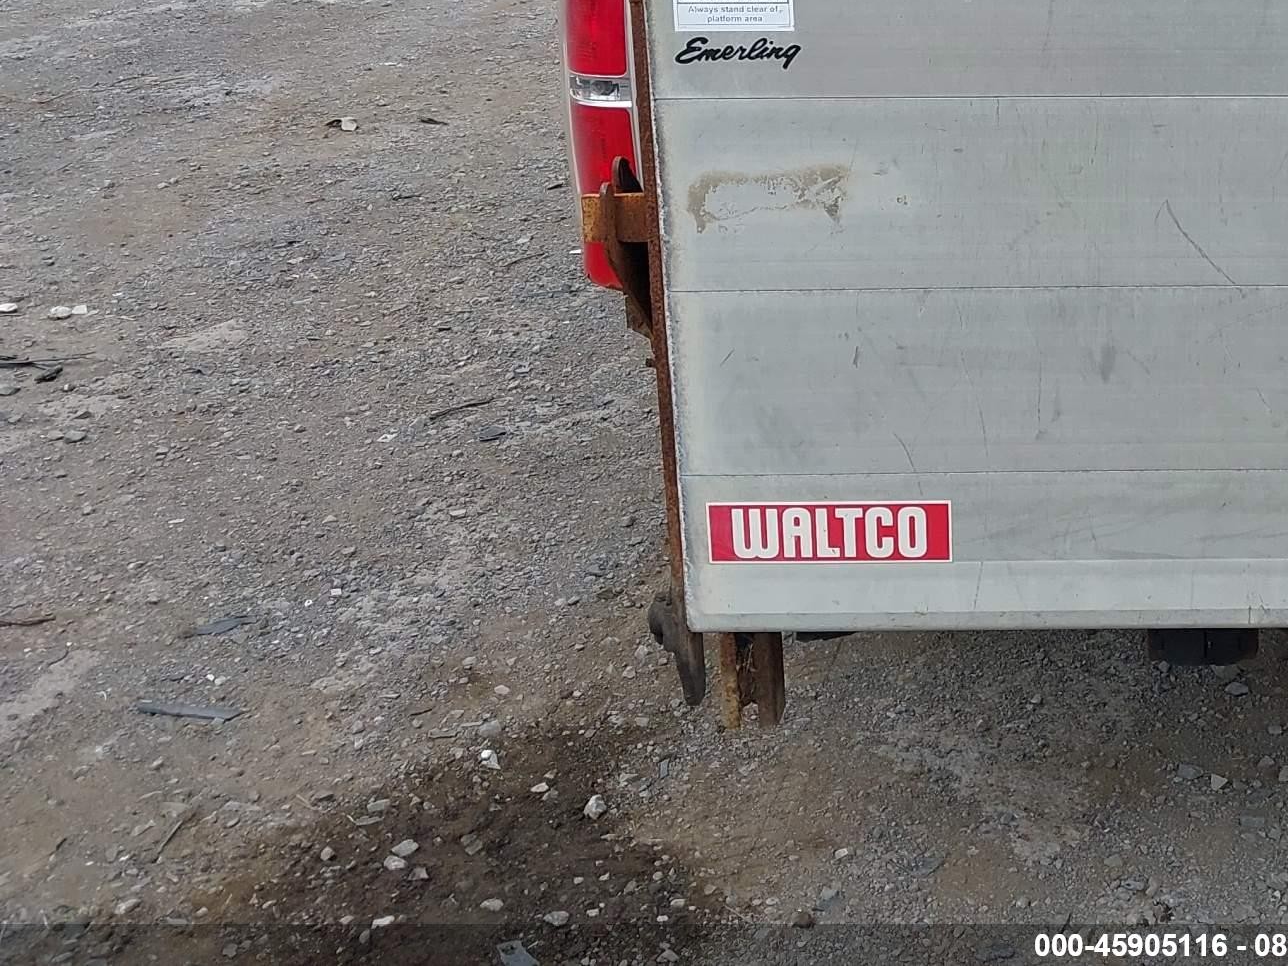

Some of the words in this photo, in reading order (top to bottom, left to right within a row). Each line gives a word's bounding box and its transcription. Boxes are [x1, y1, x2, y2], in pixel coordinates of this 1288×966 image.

[688, 6, 719, 14] Always
[721, 5, 744, 13] stand
[747, 5, 767, 13] clear
[707, 15, 742, 23] platform
[675, 36, 802, 70] Emerling
[731, 506, 928, 559] WALTCO
